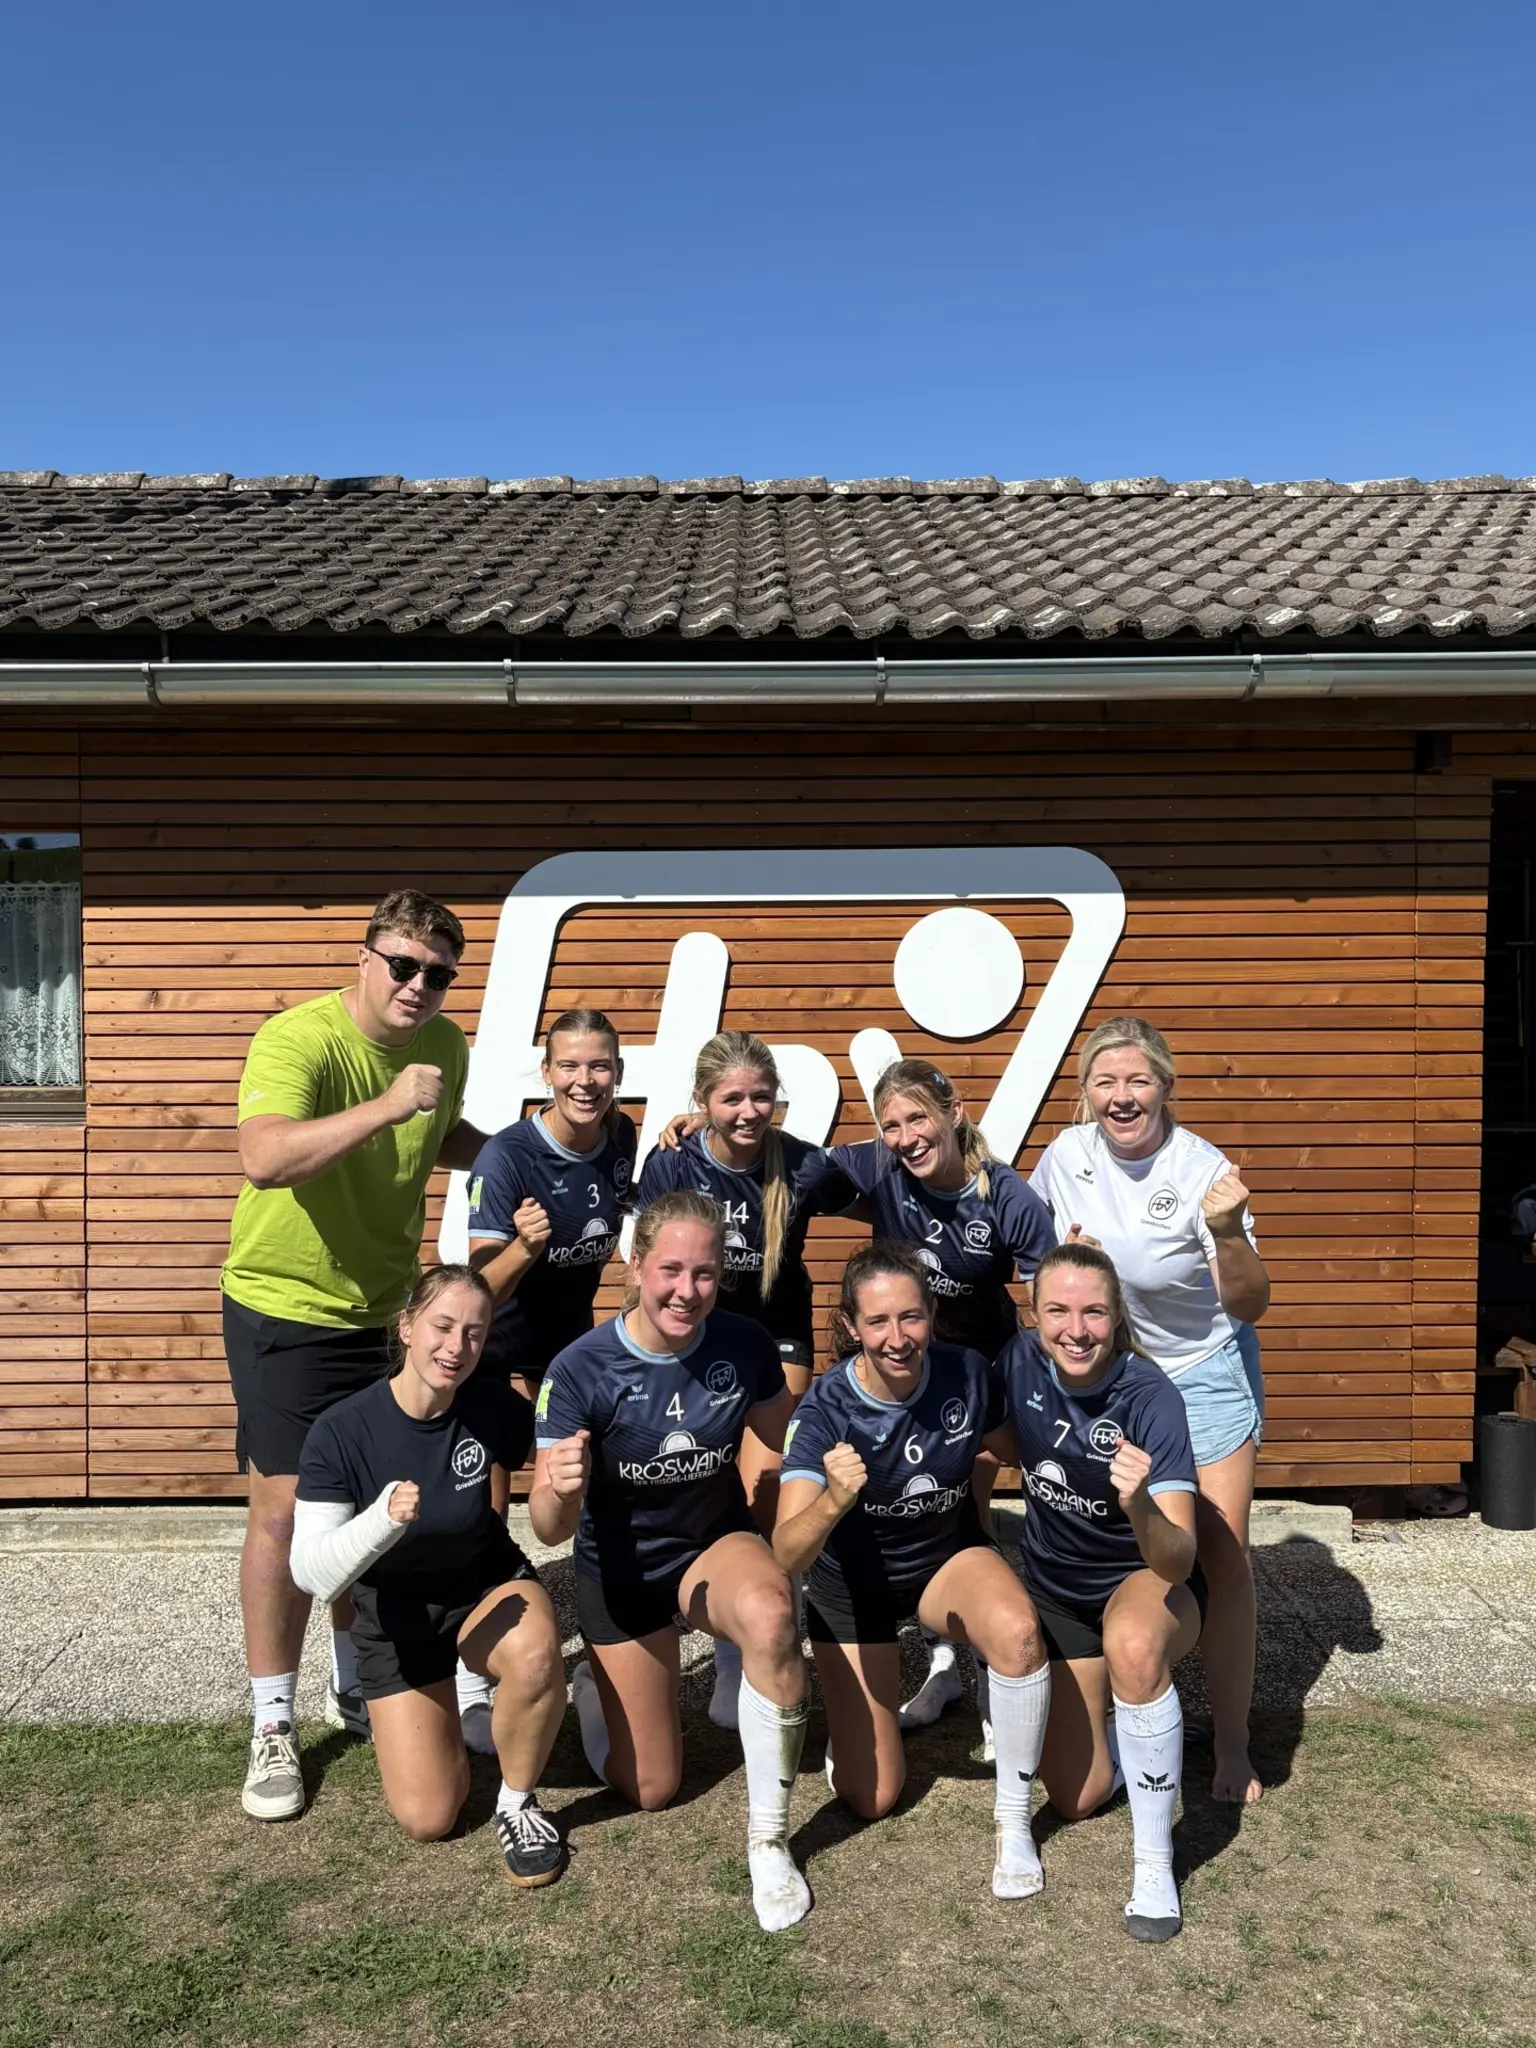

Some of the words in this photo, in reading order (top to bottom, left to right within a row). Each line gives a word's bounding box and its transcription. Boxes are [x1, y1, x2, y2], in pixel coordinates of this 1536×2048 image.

[587, 1183, 601, 1209] 3
[723, 1199, 750, 1225] 14
[924, 1218, 944, 1245] 2
[665, 1391, 686, 1422] 4
[1053, 1419, 1072, 1449] 7
[904, 1433, 924, 1465] 6
[1136, 1781, 1176, 1793] erima
